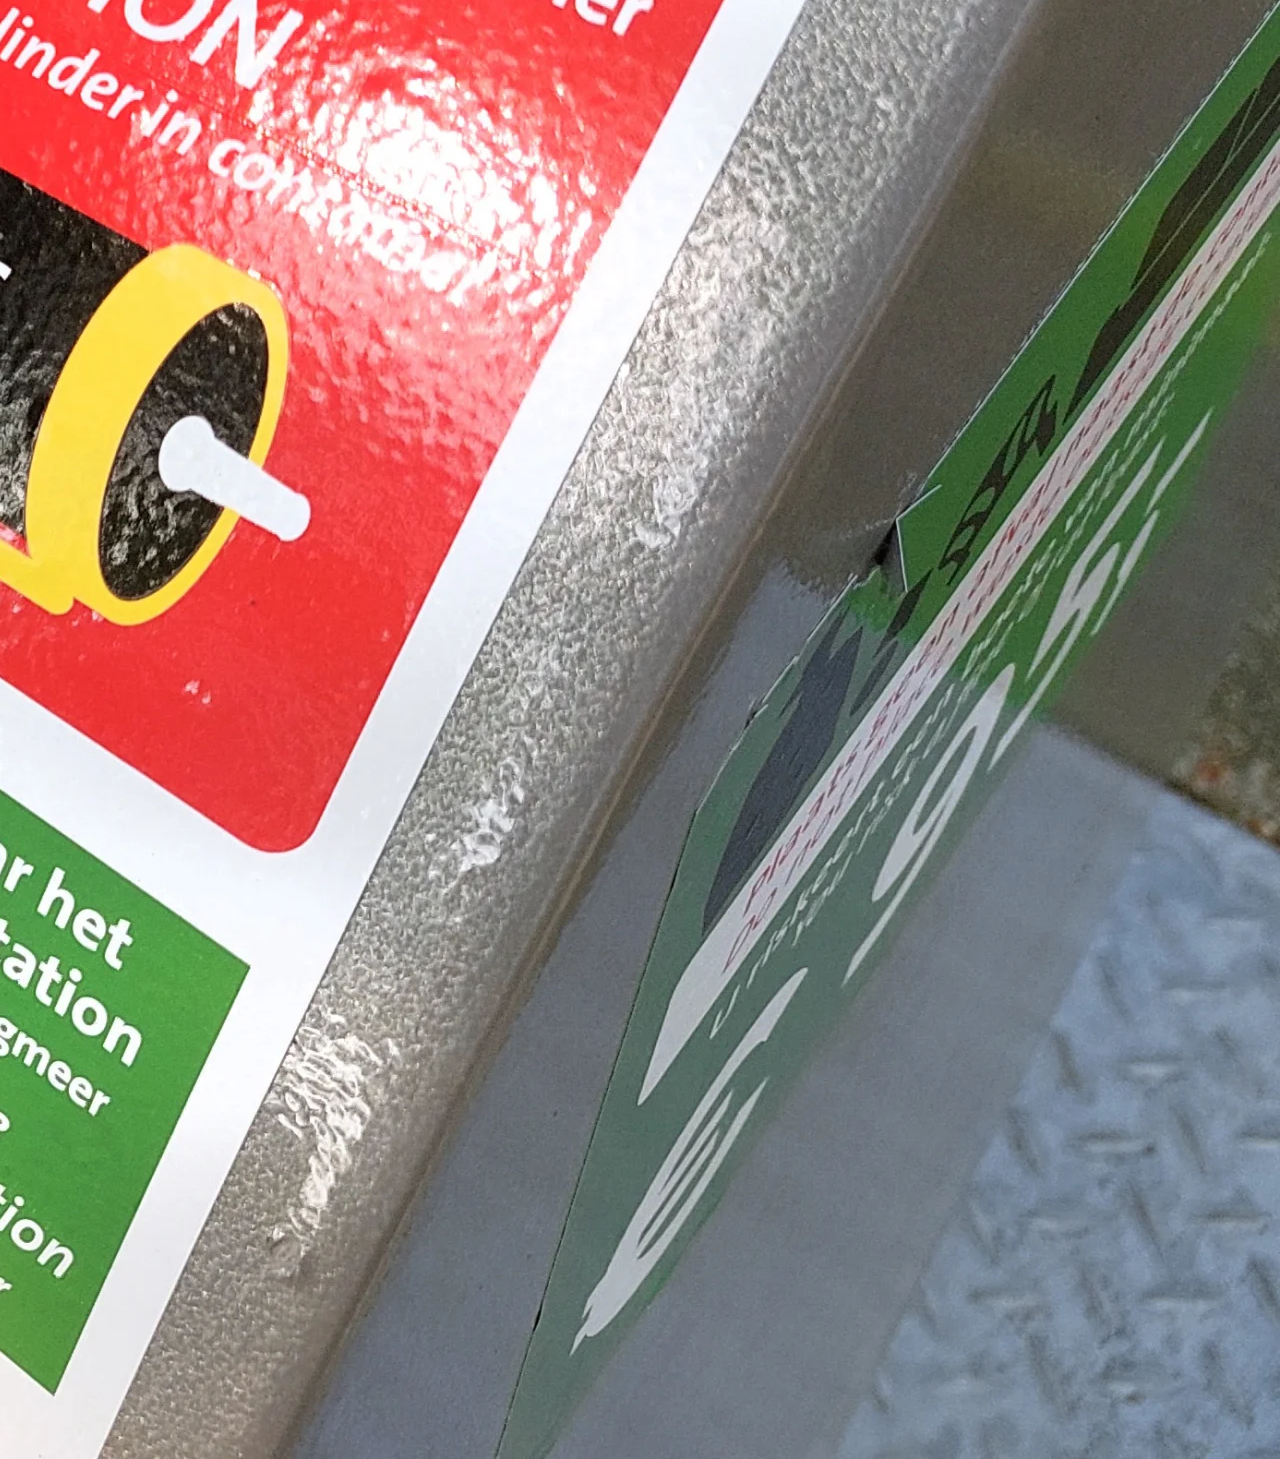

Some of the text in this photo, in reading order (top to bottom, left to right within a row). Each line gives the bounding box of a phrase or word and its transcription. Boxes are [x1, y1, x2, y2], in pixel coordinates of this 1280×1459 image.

[148, 89, 203, 154] in
[709, 983, 741, 1040] U
[746, 779, 885, 990] riskeert
[890, 683, 955, 780] een
[1064, 449, 1120, 533] van
[742, 739, 861, 918] Plaats
[864, 602, 961, 752] geen
[967, 456, 1061, 601] afval
[1062, 324, 1157, 467] naast
[1160, 263, 1203, 330] de
[36, 867, 135, 971] het
[721, 886, 778, 975] Do
[784, 778, 853, 886] not
[853, 636, 954, 795] place
